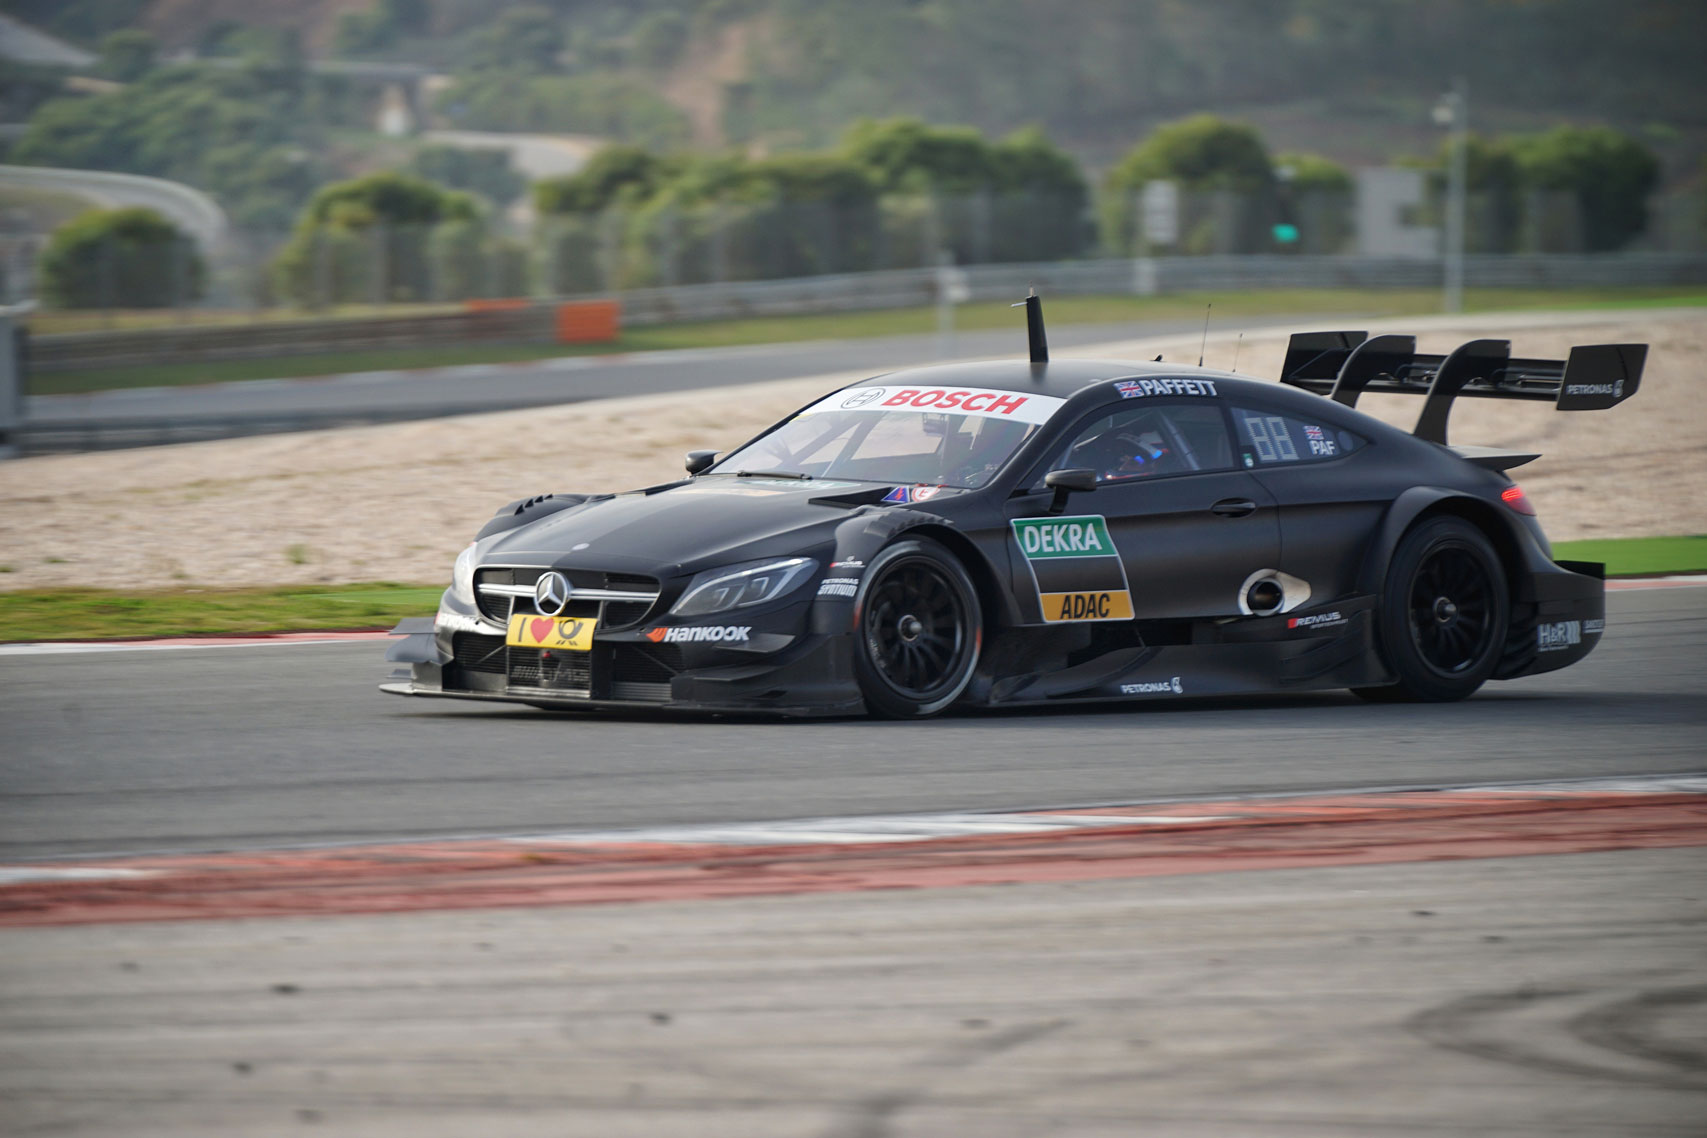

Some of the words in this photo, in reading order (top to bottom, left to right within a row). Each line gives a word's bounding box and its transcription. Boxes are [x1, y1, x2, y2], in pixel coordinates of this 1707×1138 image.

[1139, 379, 1217, 396] PAFFETT
[1567, 384, 1613, 395] PETRONAS
[881, 389, 1029, 415] BOSCH
[1309, 440, 1335, 455] PAF
[1024, 523, 1103, 553] DEKRA
[1060, 593, 1111, 619] ADAC
[1295, 611, 1341, 627] REMUS
[1538, 622, 1568, 644] H&R
[1121, 682, 1171, 693] PETRONAS
